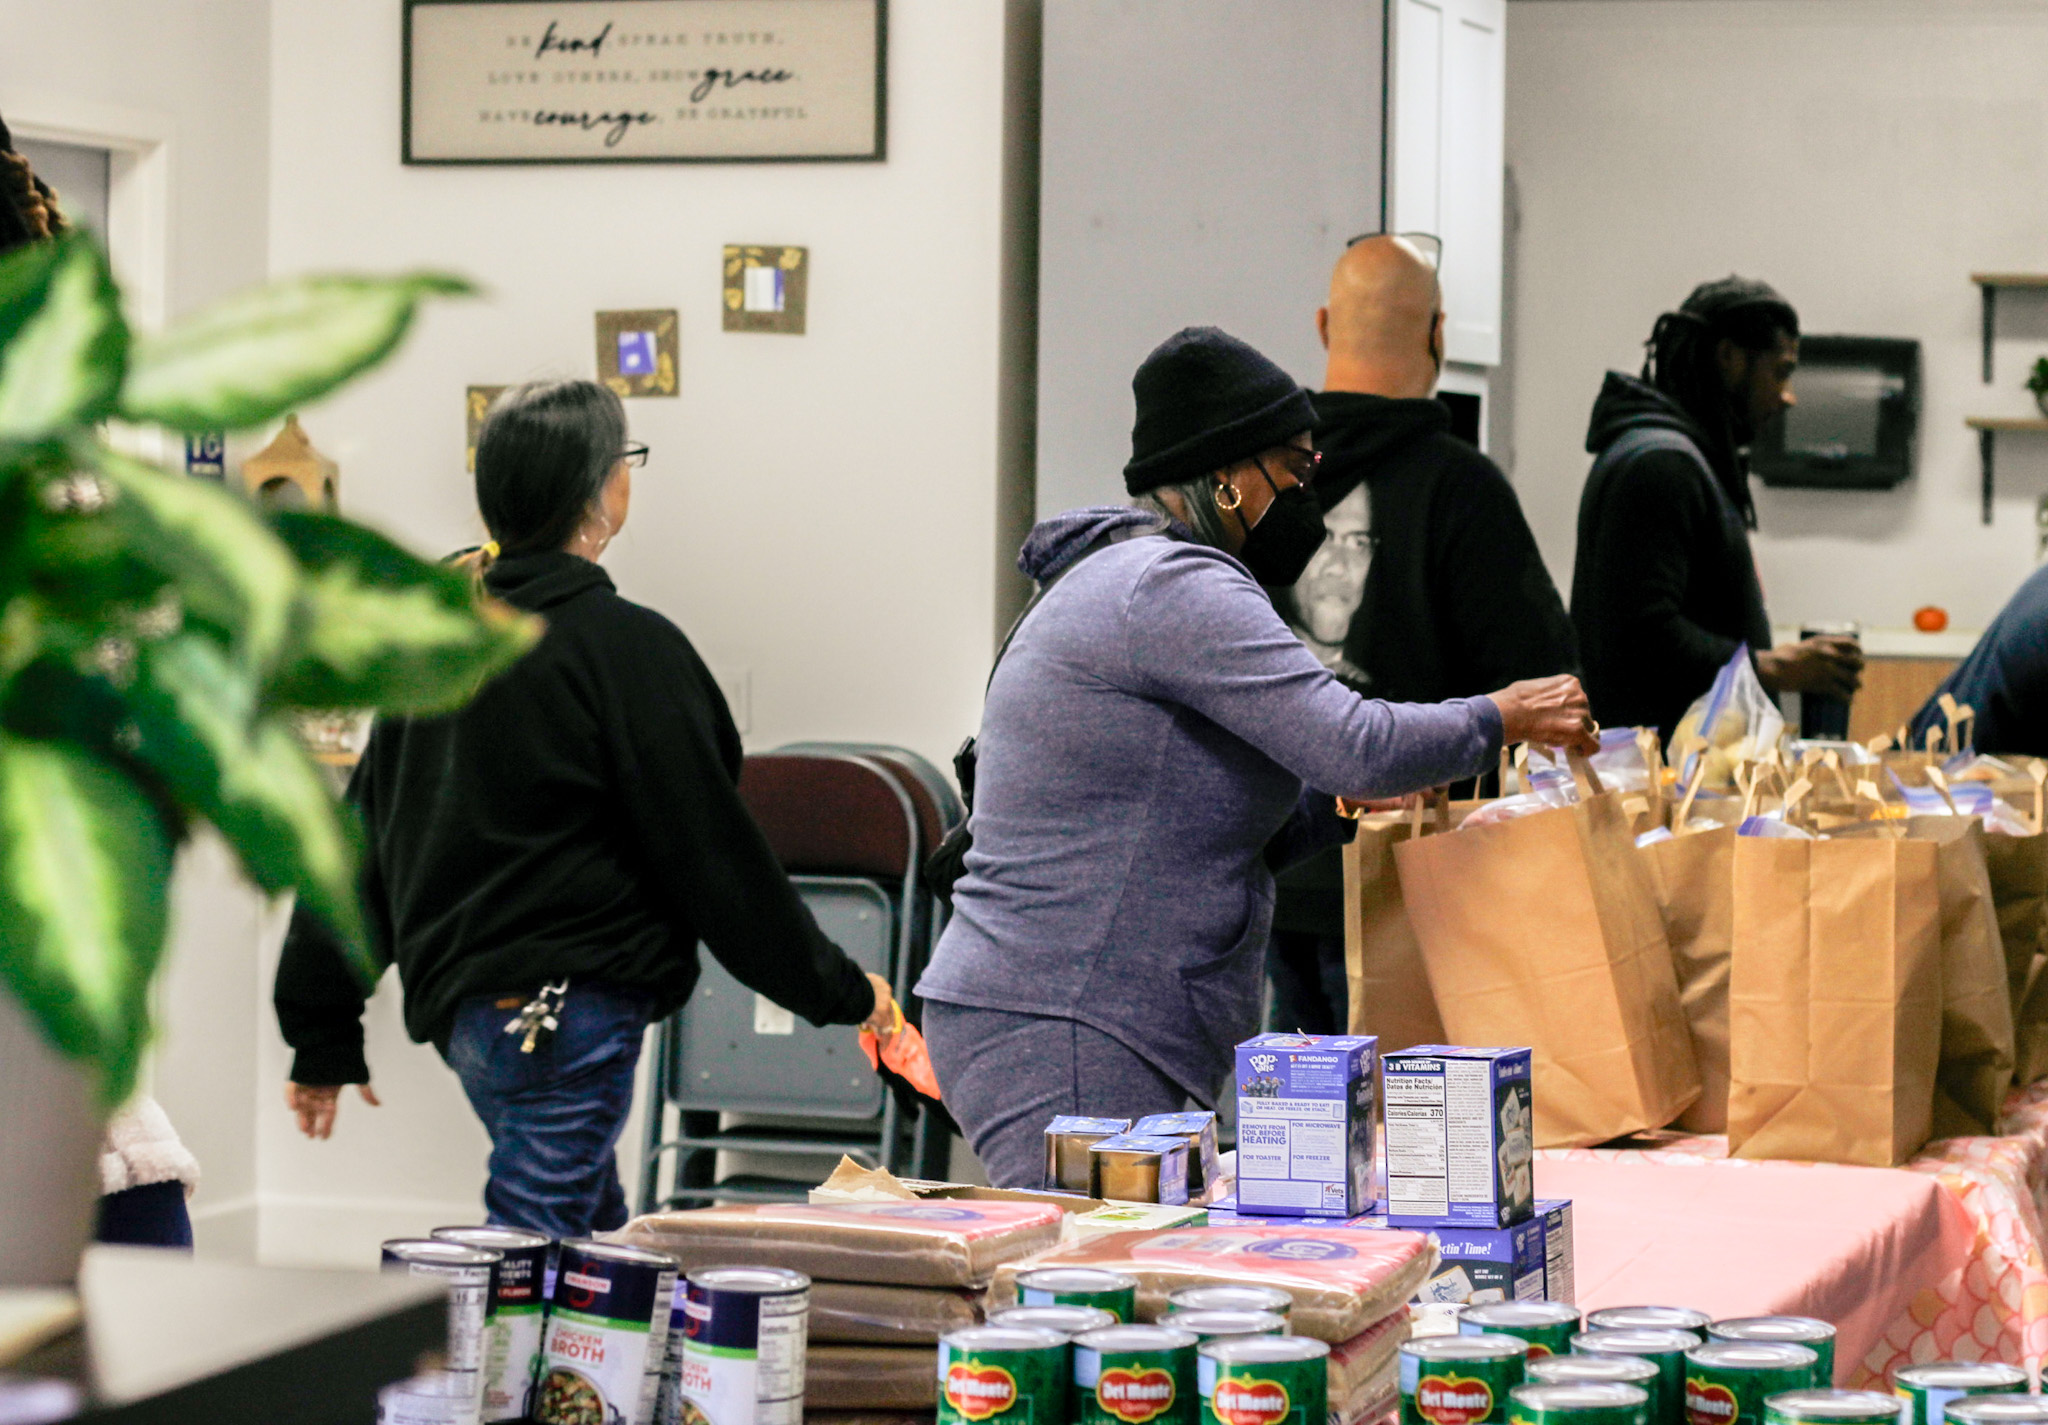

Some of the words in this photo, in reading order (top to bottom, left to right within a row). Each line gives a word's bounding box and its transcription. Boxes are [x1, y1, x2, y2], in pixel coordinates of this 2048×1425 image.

[1403, 1063, 1441, 1071] VITAMINS
[1430, 1109, 1443, 1117] 370
[1242, 1136, 1286, 1145] HEATING
[1465, 1242, 1492, 1255] Time!
[556, 1328, 603, 1345] CHICKEN
[551, 1337, 606, 1363] BROTH
